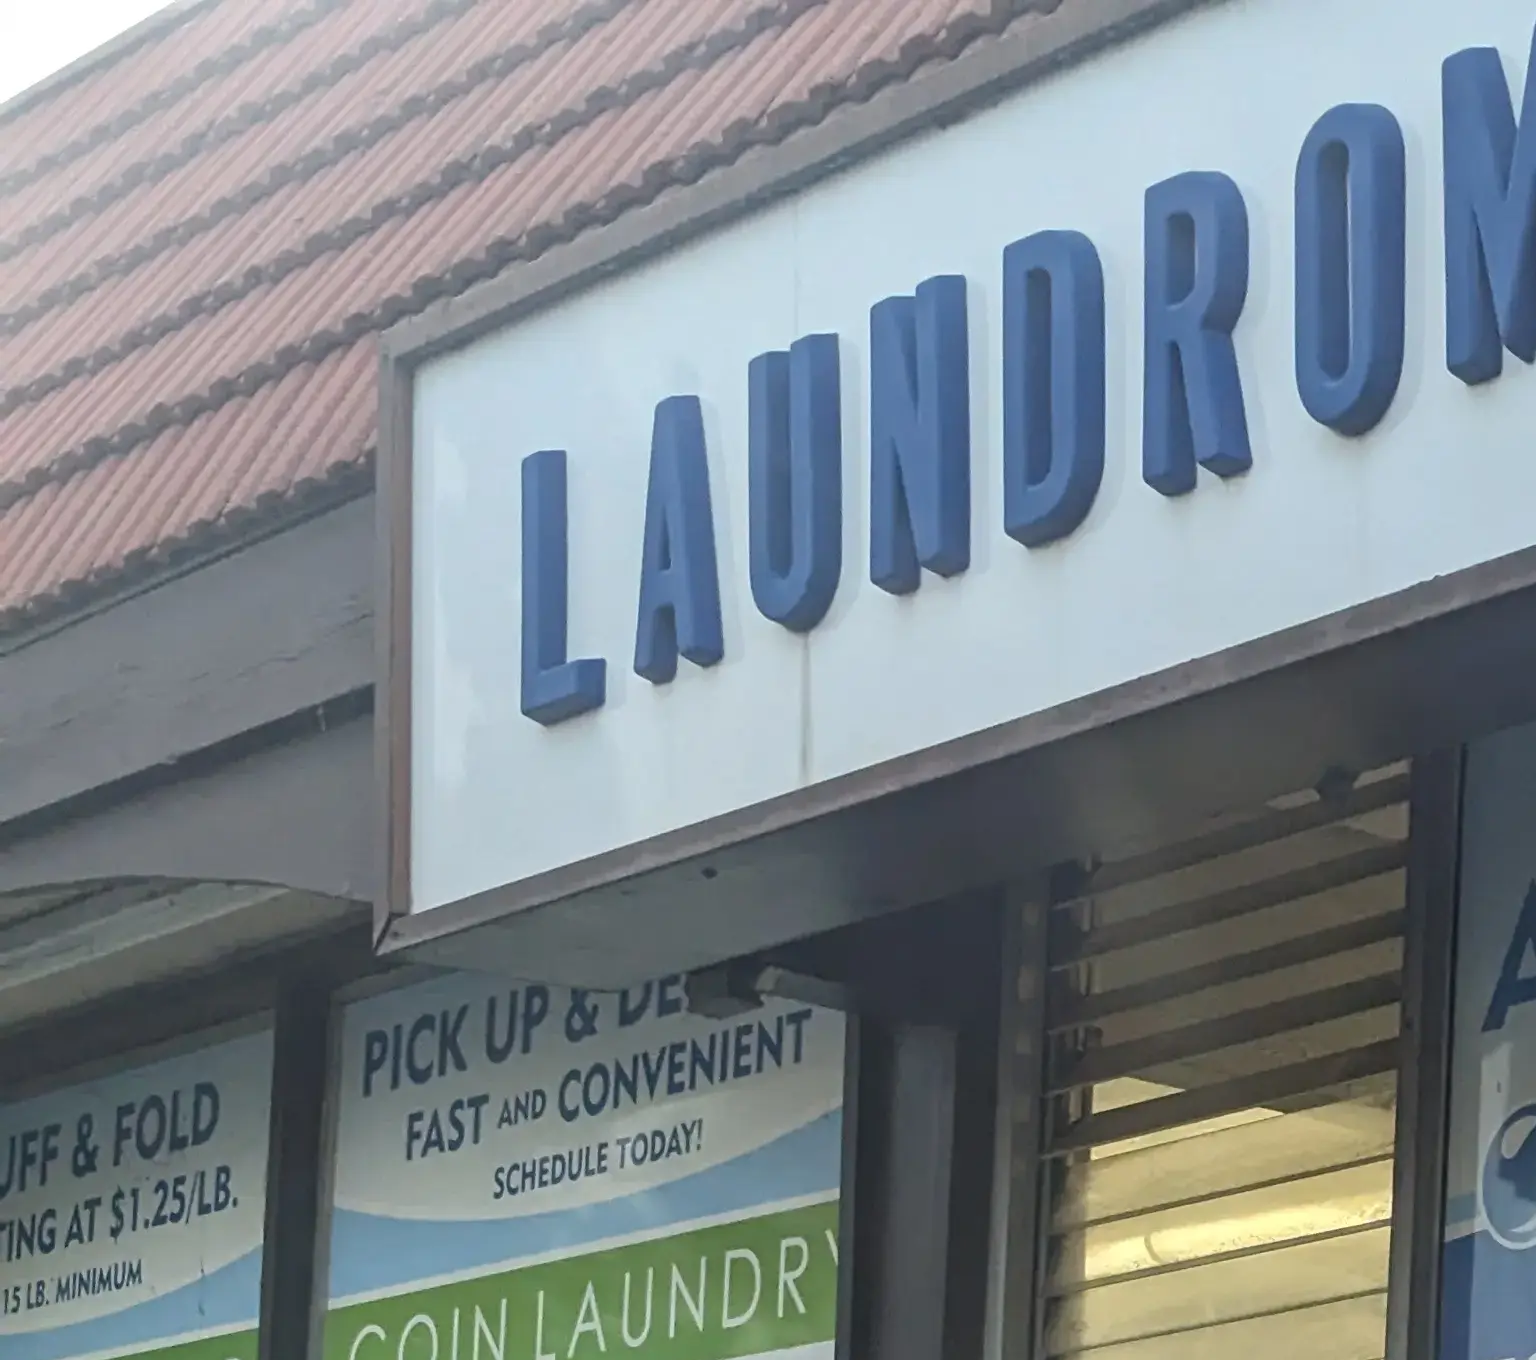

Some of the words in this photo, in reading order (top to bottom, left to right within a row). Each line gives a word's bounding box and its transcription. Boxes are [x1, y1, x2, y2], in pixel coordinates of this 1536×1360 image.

[363, 1003, 470, 1099] PICK
[486, 984, 550, 1064] UP
[406, 1094, 489, 1161] FAST
[497, 1088, 547, 1130] AND
[558, 1008, 813, 1123] CONVENIENT
[0, 1123, 62, 1199] UFF
[72, 1112, 99, 1178] &
[112, 1081, 221, 1168] FOLD
[493, 1142, 608, 1200] SCHEDULE
[616, 1118, 704, 1171] TODAY!
[64, 1196, 103, 1249] AT
[109, 1164, 239, 1245] $1.25/LB.
[3, 1286, 21, 1315] 15
[26, 1279, 50, 1311] LB.
[55, 1258, 143, 1304] MINIMUM
